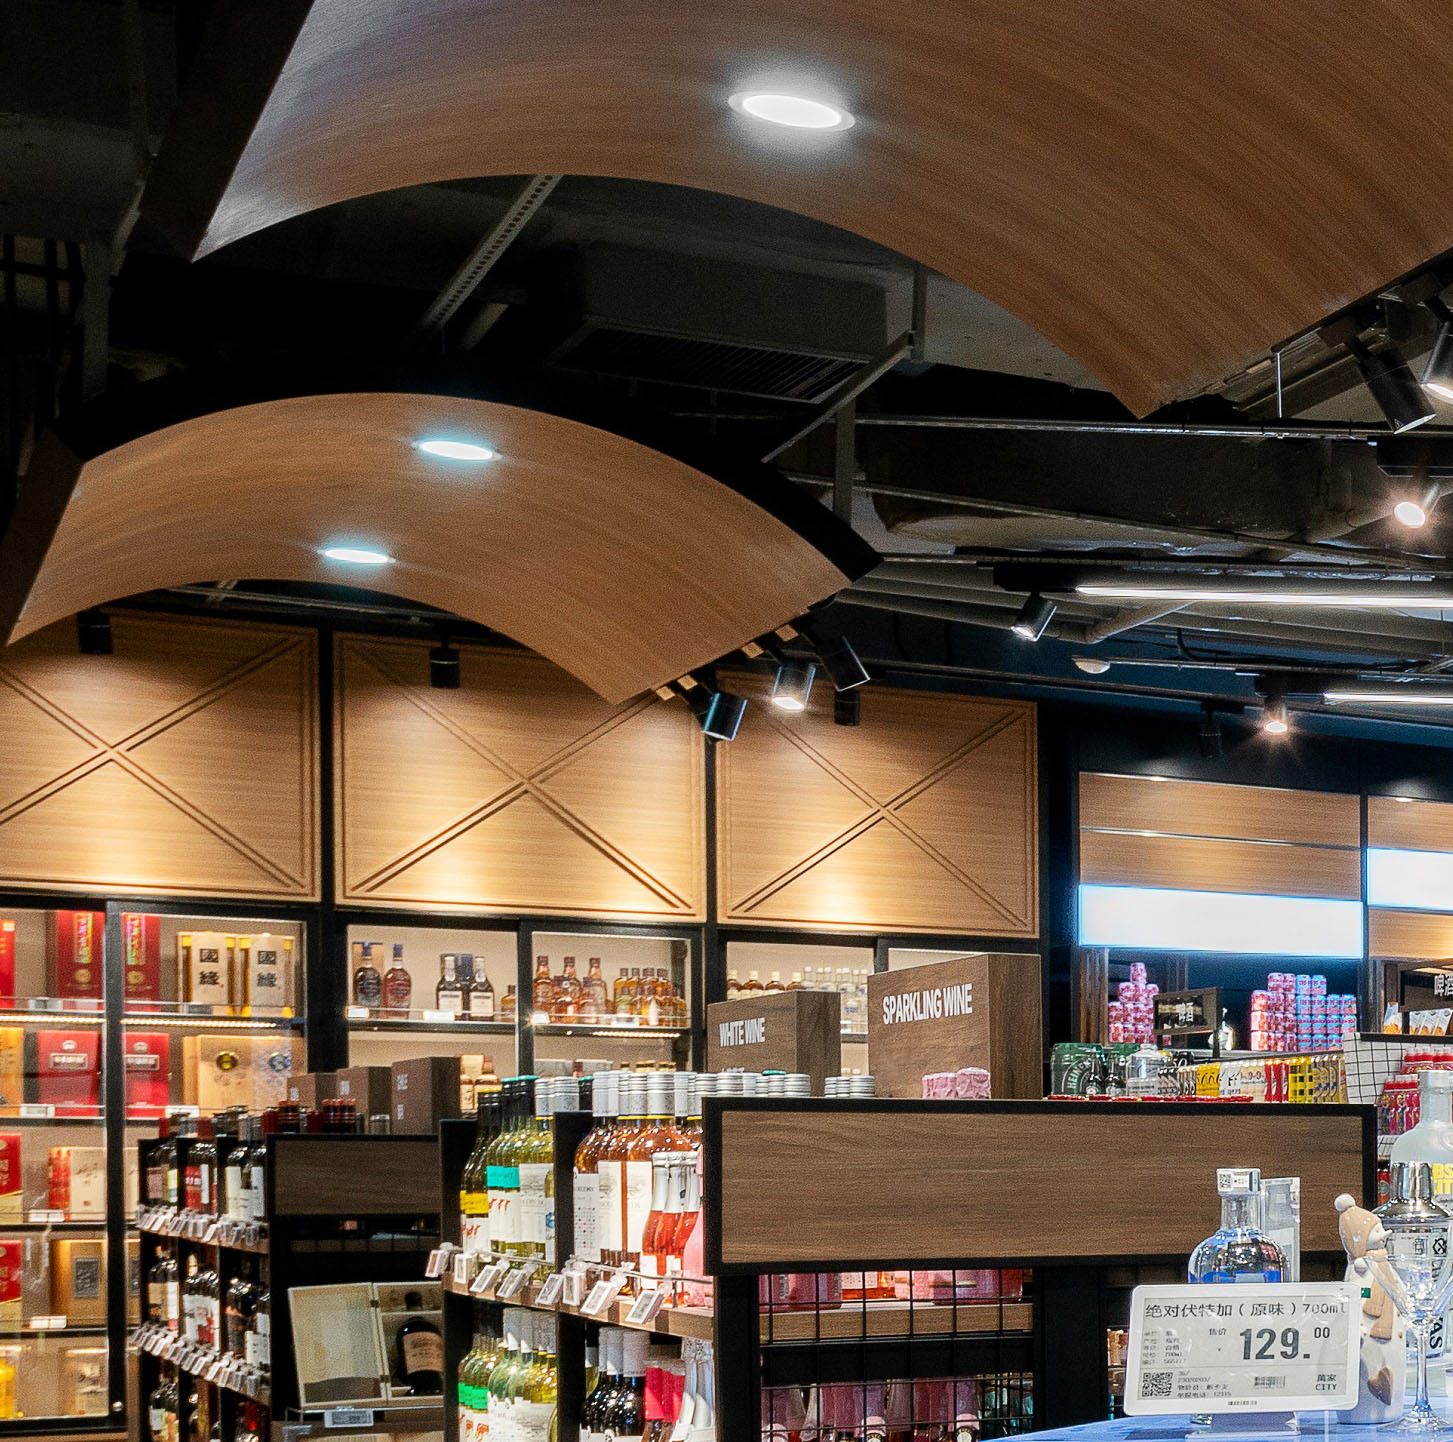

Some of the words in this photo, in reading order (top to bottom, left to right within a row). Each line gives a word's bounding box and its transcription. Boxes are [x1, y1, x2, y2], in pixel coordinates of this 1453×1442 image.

[882, 987, 942, 1025] SPARKLING
[944, 983, 973, 1017] WINE
[719, 1020, 745, 1048] WHITE
[744, 1017, 766, 1045] WINE
[1315, 1383, 1338, 1392] CITY
